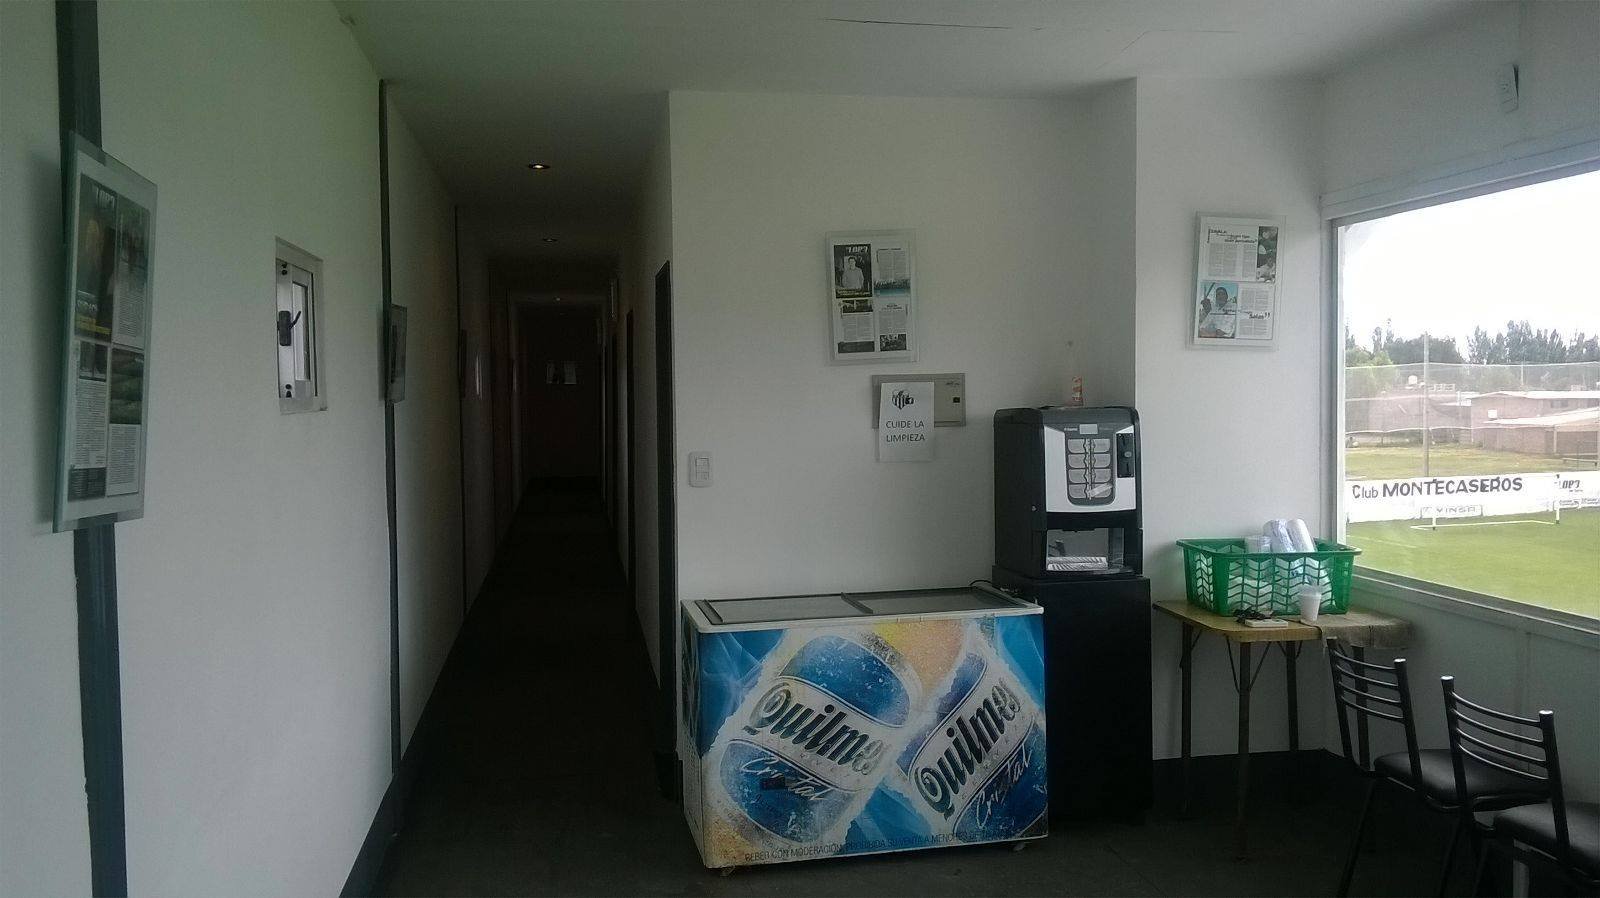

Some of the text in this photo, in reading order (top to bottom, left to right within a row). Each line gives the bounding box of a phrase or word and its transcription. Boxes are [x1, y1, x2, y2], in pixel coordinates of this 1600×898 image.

[886, 420, 925, 429] CUIDE LA
[886, 433, 925, 442] LIMPIEZA
[1352, 477, 1523, 499] Club MONTECASEROS
[743, 682, 889, 775] Quilmes
[914, 677, 1021, 821] Quilmes
[744, 851, 769, 862] BEBER
[772, 848, 789, 859] CON
